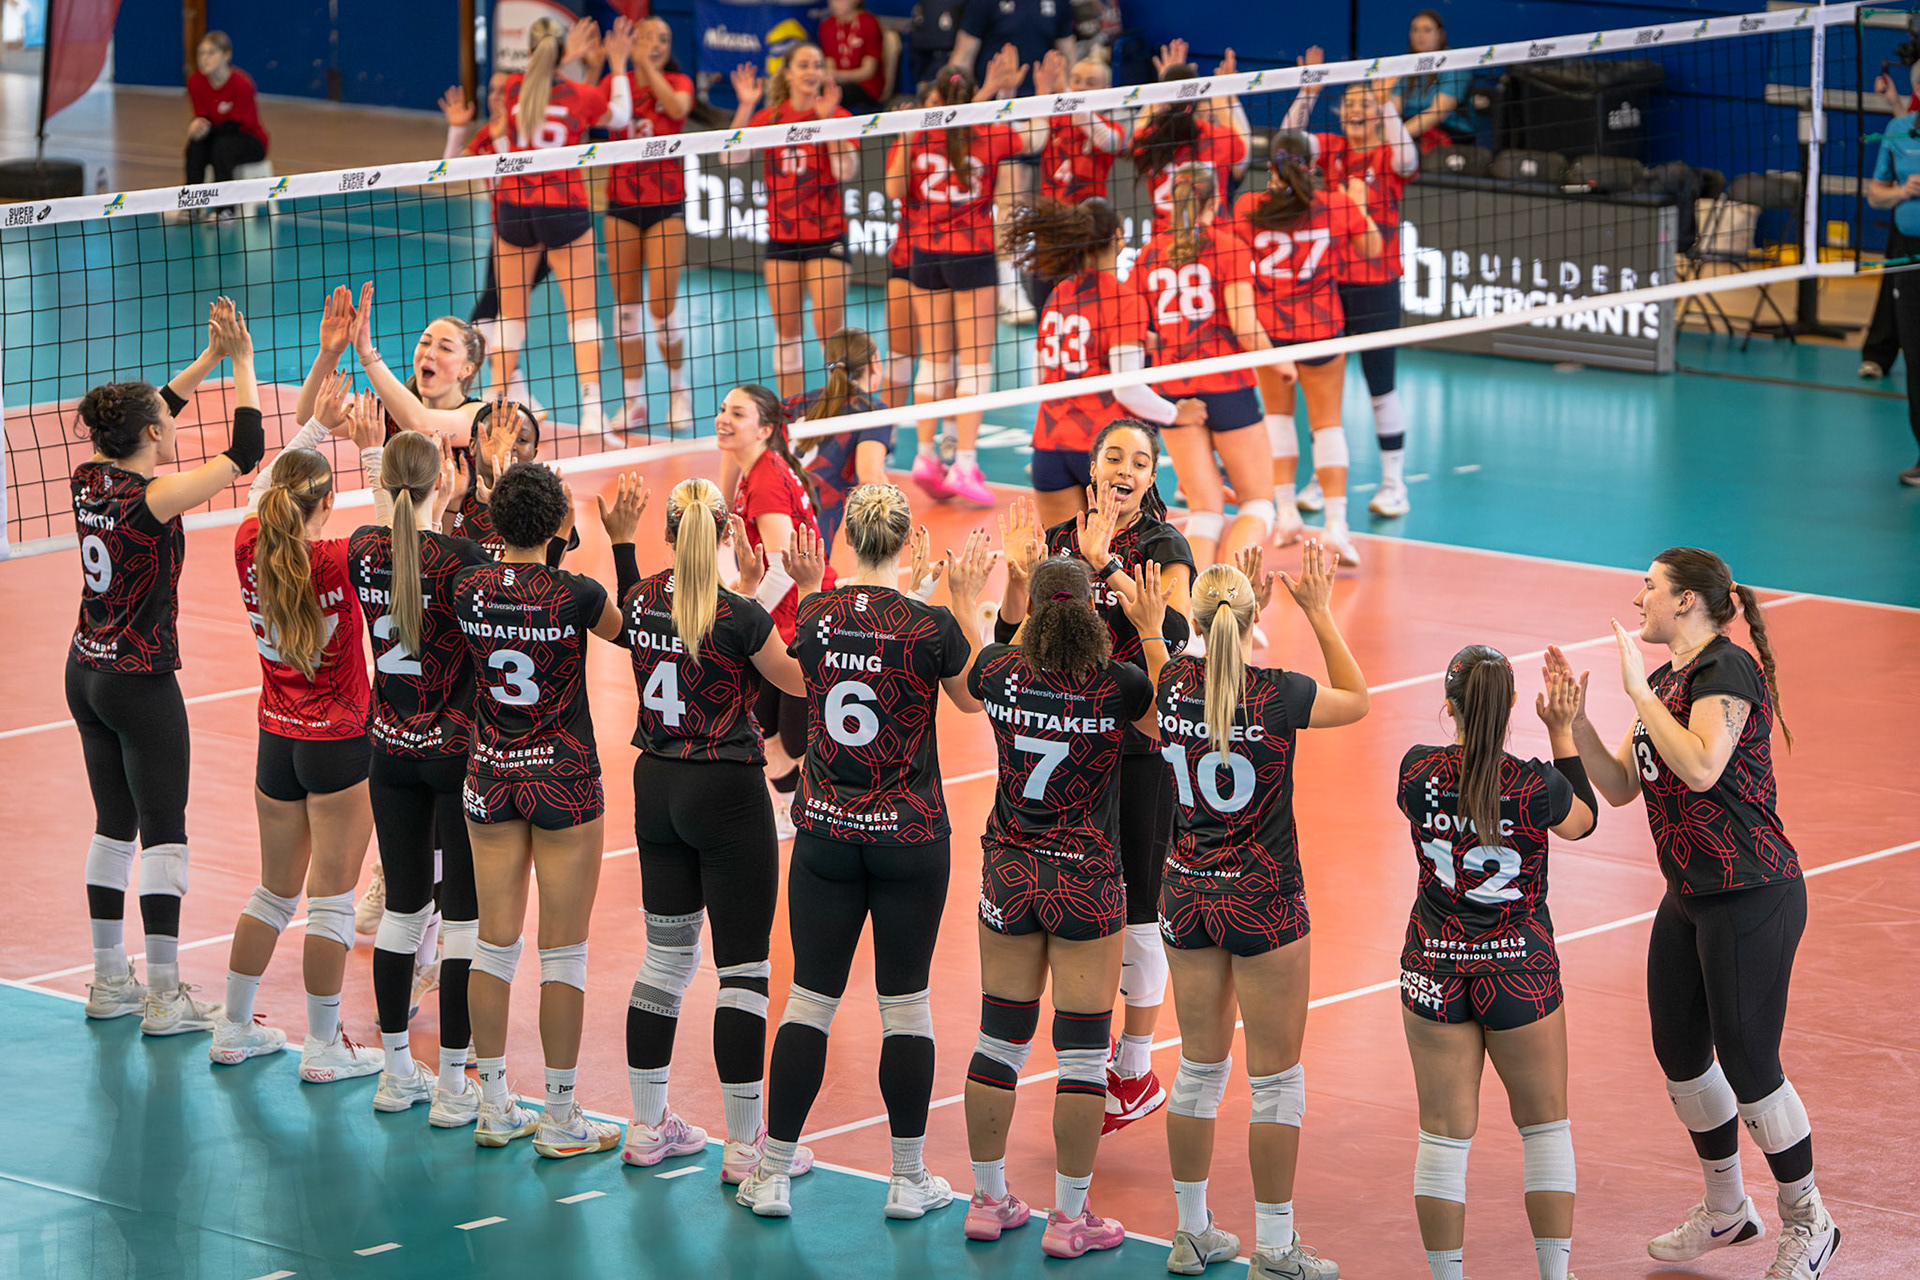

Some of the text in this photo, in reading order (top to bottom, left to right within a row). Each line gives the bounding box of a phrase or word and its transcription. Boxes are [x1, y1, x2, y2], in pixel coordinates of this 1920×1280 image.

[338, 180, 365, 191] LEAGUE
[342, 172, 365, 182] SUPER
[9, 205, 34, 217] SUPER
[177, 197, 210, 208] ENGLAND
[5, 214, 34, 226] LEAGUE
[1254, 228, 1331, 280] 27
[1148, 263, 1216, 325] 28
[1041, 311, 1091, 374] 33
[78, 508, 114, 531] SMITH
[82, 534, 112, 593] 9
[358, 586, 432, 609] BRIT
[487, 602, 516, 612] University
[644, 607, 672, 621] University
[456, 614, 576, 642] UNDAFUNDA
[834, 627, 866, 640] University
[875, 631, 896, 640] Essex
[373, 614, 422, 676] 2
[627, 628, 684, 653] TOLLE
[825, 650, 883, 673] KING
[488, 649, 540, 706] 3
[642, 660, 687, 727] 4
[1021, 687, 1055, 700] University
[1064, 692, 1086, 701] Essex
[825, 680, 880, 747] 6
[984, 697, 1116, 734] WHITTAKER
[1157, 710, 1265, 742] BOROEC
[508, 745, 555, 759] REBELS
[1014, 734, 1070, 801] 7
[1160, 741, 1257, 813] 10
[805, 809, 825, 821] BOLD
[1420, 837, 1524, 904] 12
[1422, 950, 1527, 960] BOLD CURIOUS BRAVE
[1424, 936, 1526, 952] ESSEX REBELS
